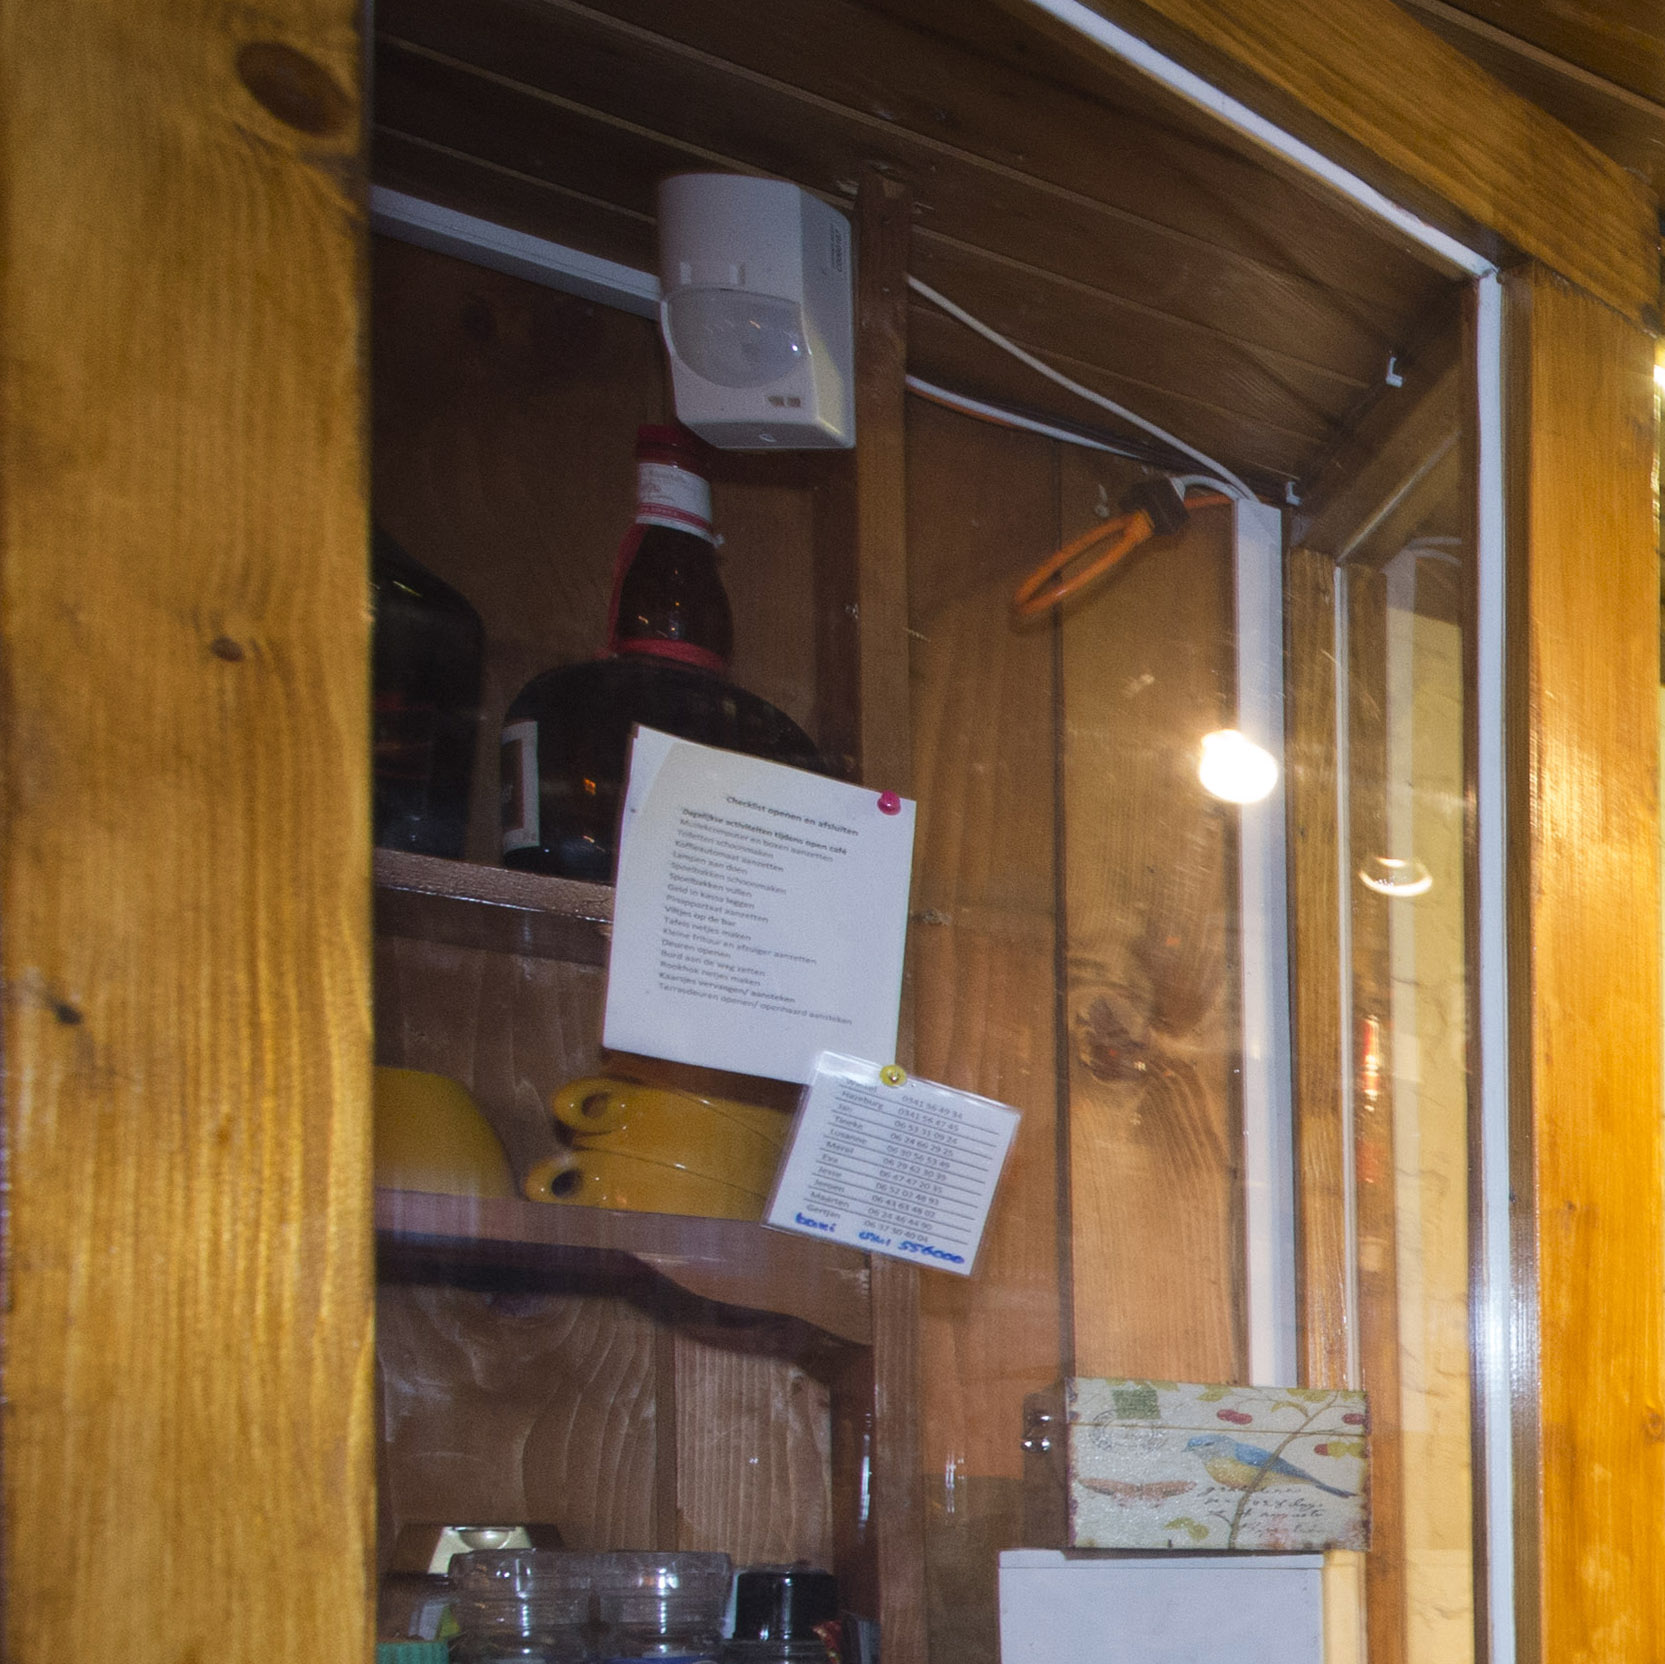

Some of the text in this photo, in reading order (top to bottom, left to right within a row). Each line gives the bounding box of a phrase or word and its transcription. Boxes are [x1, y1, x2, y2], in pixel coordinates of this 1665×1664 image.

[726, 795, 858, 837] Checklist openen en afsluiten
[680, 817, 833, 863] Muziekcomputer en boxen aanzetten
[682, 807, 846, 855] Dagelijkse activiteiten tijdens open café
[675, 838, 783, 873] Koffieautomaat aanzetten
[677, 828, 773, 859] Toiletten schoonmaken
[673, 850, 747, 874] Lampen aan doen
[669, 872, 752, 898] Spoelbakken vullen
[671, 861, 784, 894] Spoelbakken schoonmaken
[667, 882, 754, 910] Geld in kassa leggen
[664, 904, 735, 927] Viltjes op de bar
[724, 907, 768, 924] aanzetten
[664, 916, 751, 941] Tafels netjes maken
[661, 938, 730, 960] Deuren openen
[662, 927, 689, 939] Kleine
[736, 943, 770, 957] afzuiger
[773, 950, 816, 965] aanzetten
[660, 960, 760, 986] Rookhok netjes maken
[661, 949, 765, 977] Bord aan de weg zetten
[659, 971, 795, 1004] Kaarsjes vervangen/ aansteken
[659, 981, 852, 1025] Terrasdeuren openen/ openhaard aansteken
[894, 1119, 905, 1129] 06
[897, 1106, 919, 1120] 0341
[890, 1131, 901, 1141] 06
[883, 1156, 894, 1166] 06
[886, 1144, 898, 1154] 06
[879, 1168, 890, 1179] 06
[871, 1193, 883, 1203] 06
[876, 1181, 887, 1191] 06
[867, 1206, 878, 1216] 06
[863, 1219, 876, 1229] 06
